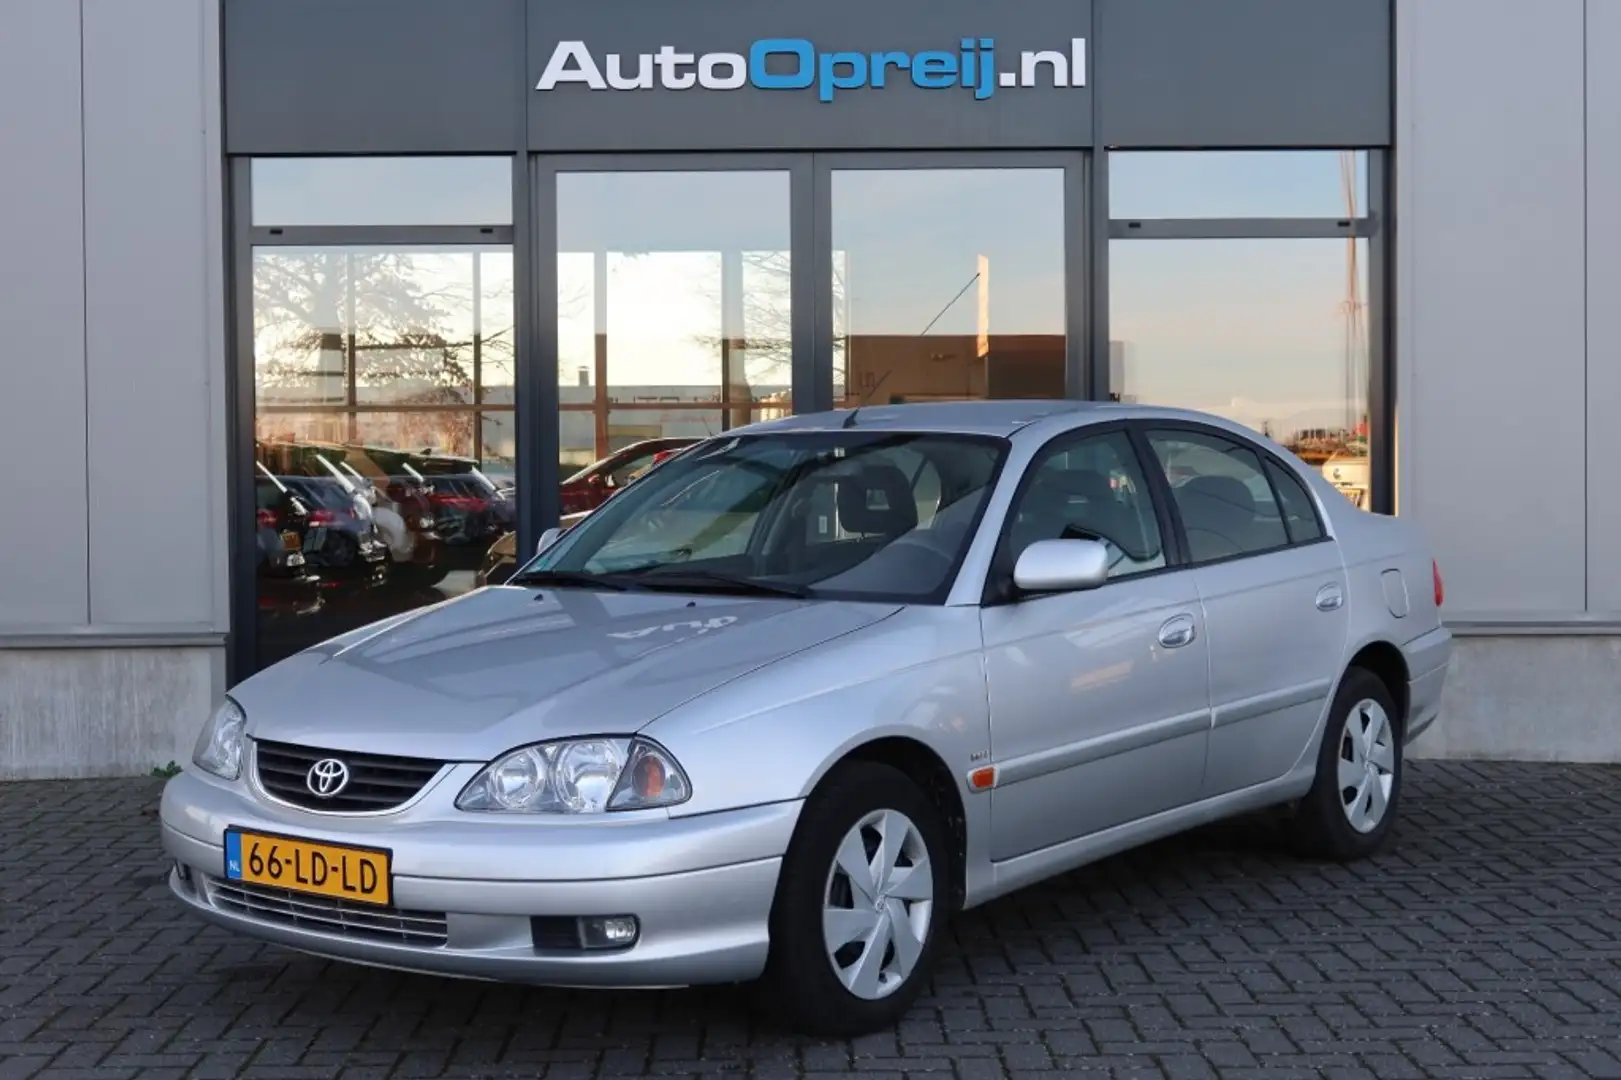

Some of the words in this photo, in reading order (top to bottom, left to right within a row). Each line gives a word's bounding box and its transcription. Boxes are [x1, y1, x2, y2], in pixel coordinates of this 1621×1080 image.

[535, 37, 1087, 103] AutoOpreij.nl
[229, 859, 241, 872] NL
[249, 842, 377, 894] 66-LD-LD
